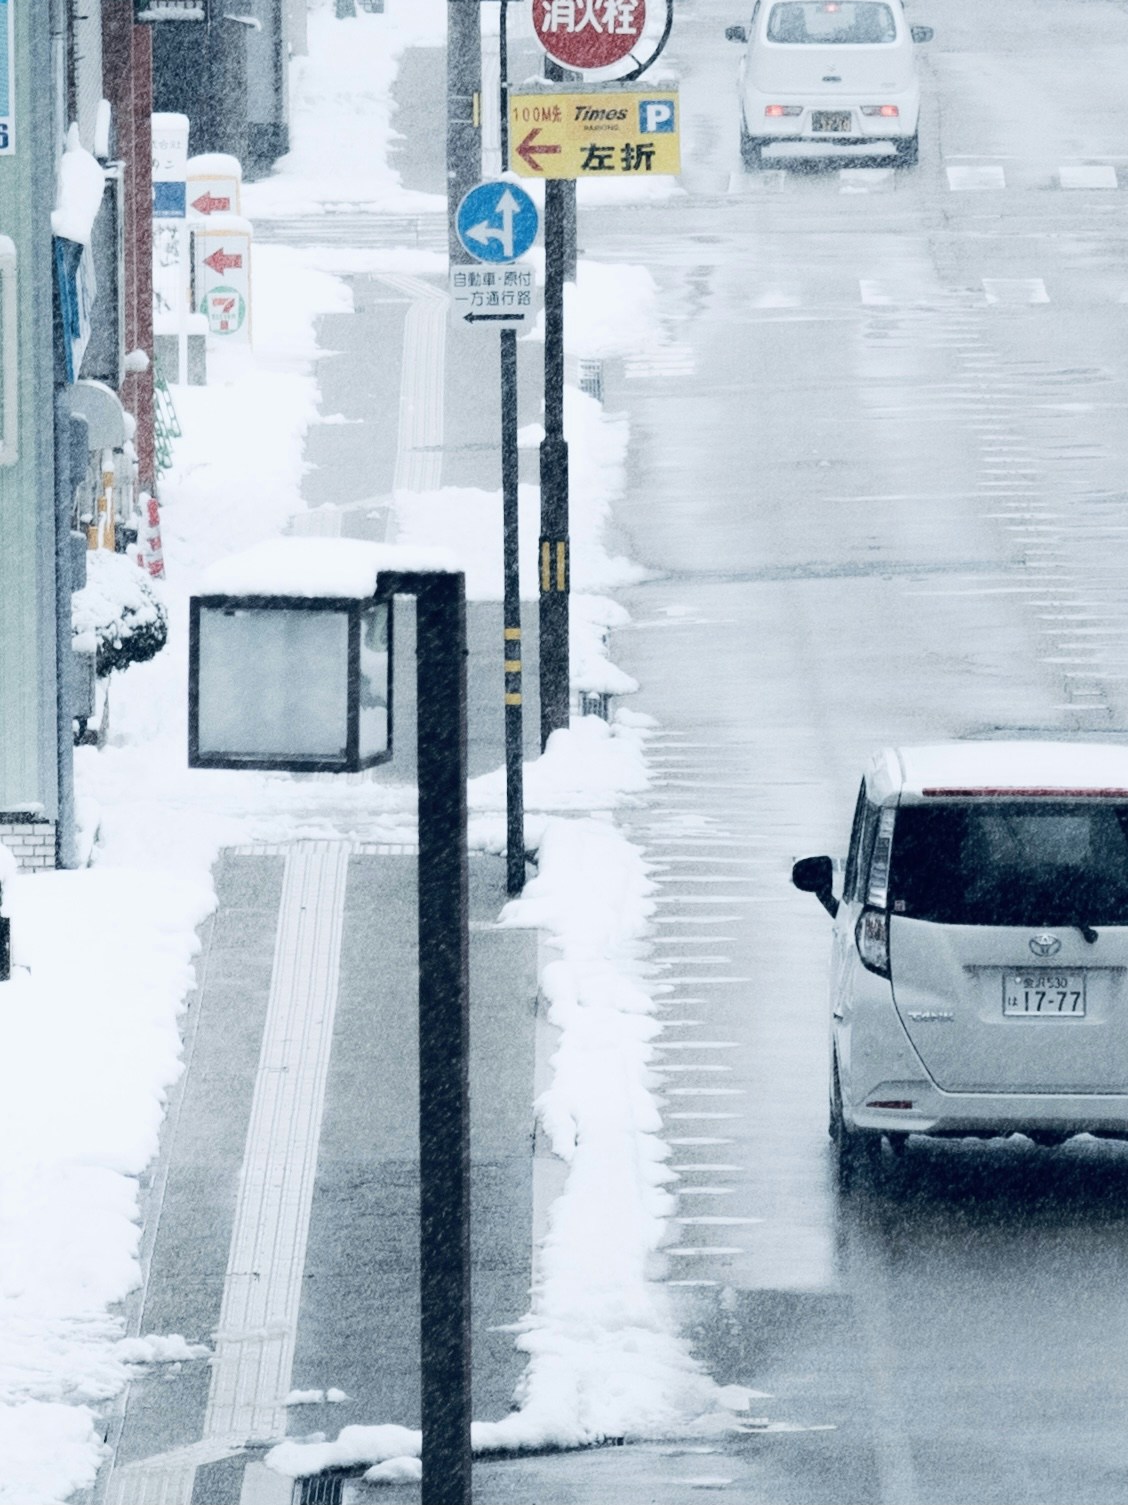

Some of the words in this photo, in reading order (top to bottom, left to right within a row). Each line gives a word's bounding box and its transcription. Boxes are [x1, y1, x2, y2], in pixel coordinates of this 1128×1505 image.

[573, 104, 629, 122] Times
[646, 104, 671, 132] P
[580, 142, 656, 172] 左折
[454, 290, 532, 307] 一方通行路
[1023, 990, 1082, 1013] 17-77
